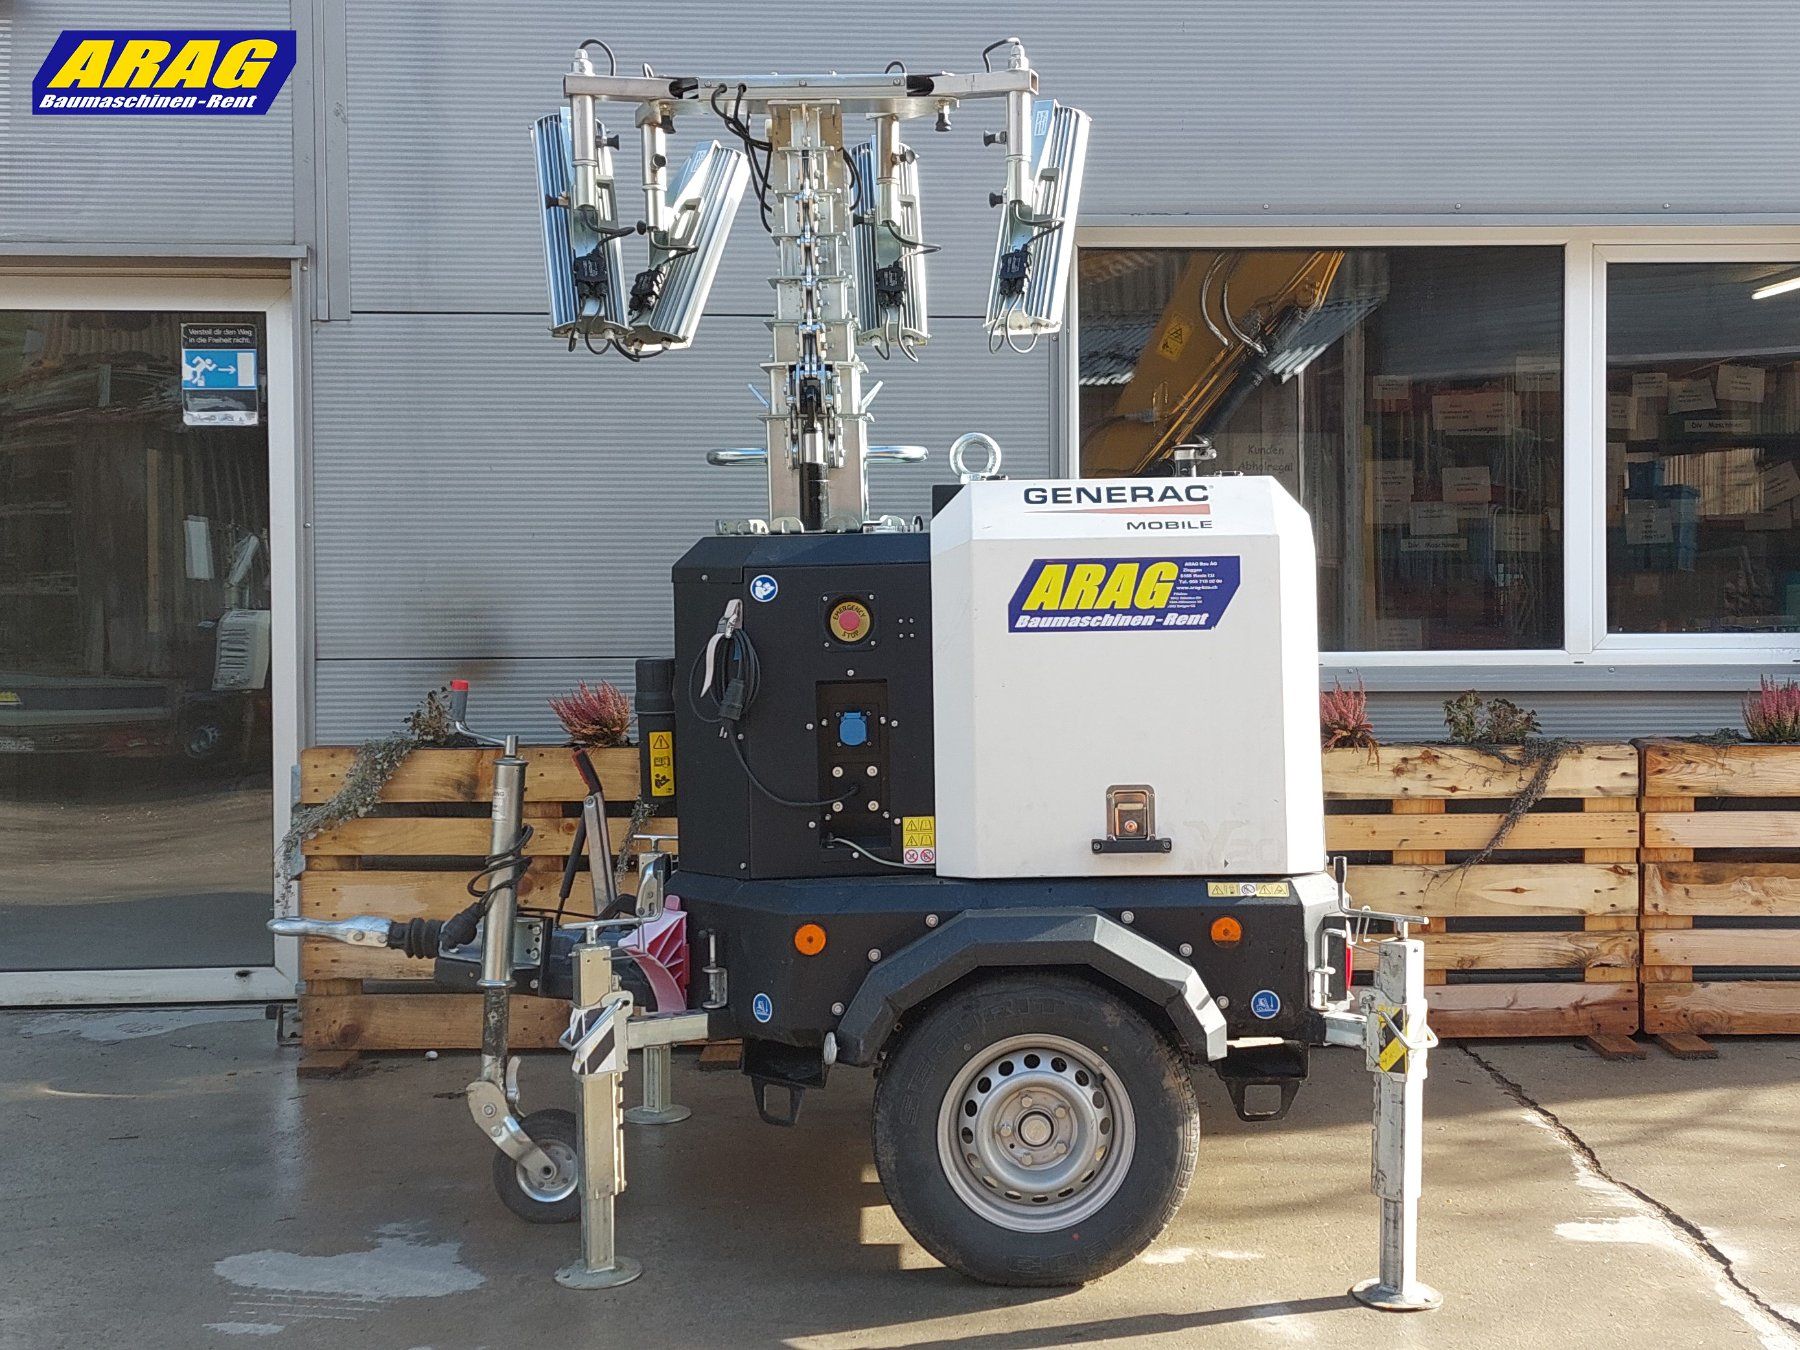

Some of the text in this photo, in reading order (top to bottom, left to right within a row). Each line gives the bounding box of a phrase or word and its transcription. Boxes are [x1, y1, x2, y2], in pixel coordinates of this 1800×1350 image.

[1248, 444, 1284, 455] Kunden
[1023, 485, 1209, 504] GENERAC
[1127, 520, 1213, 530] MOBILE
[1021, 561, 1179, 611] ARAG
[833, 604, 866, 620] EMERGENCY
[842, 630, 859, 639] STOP
